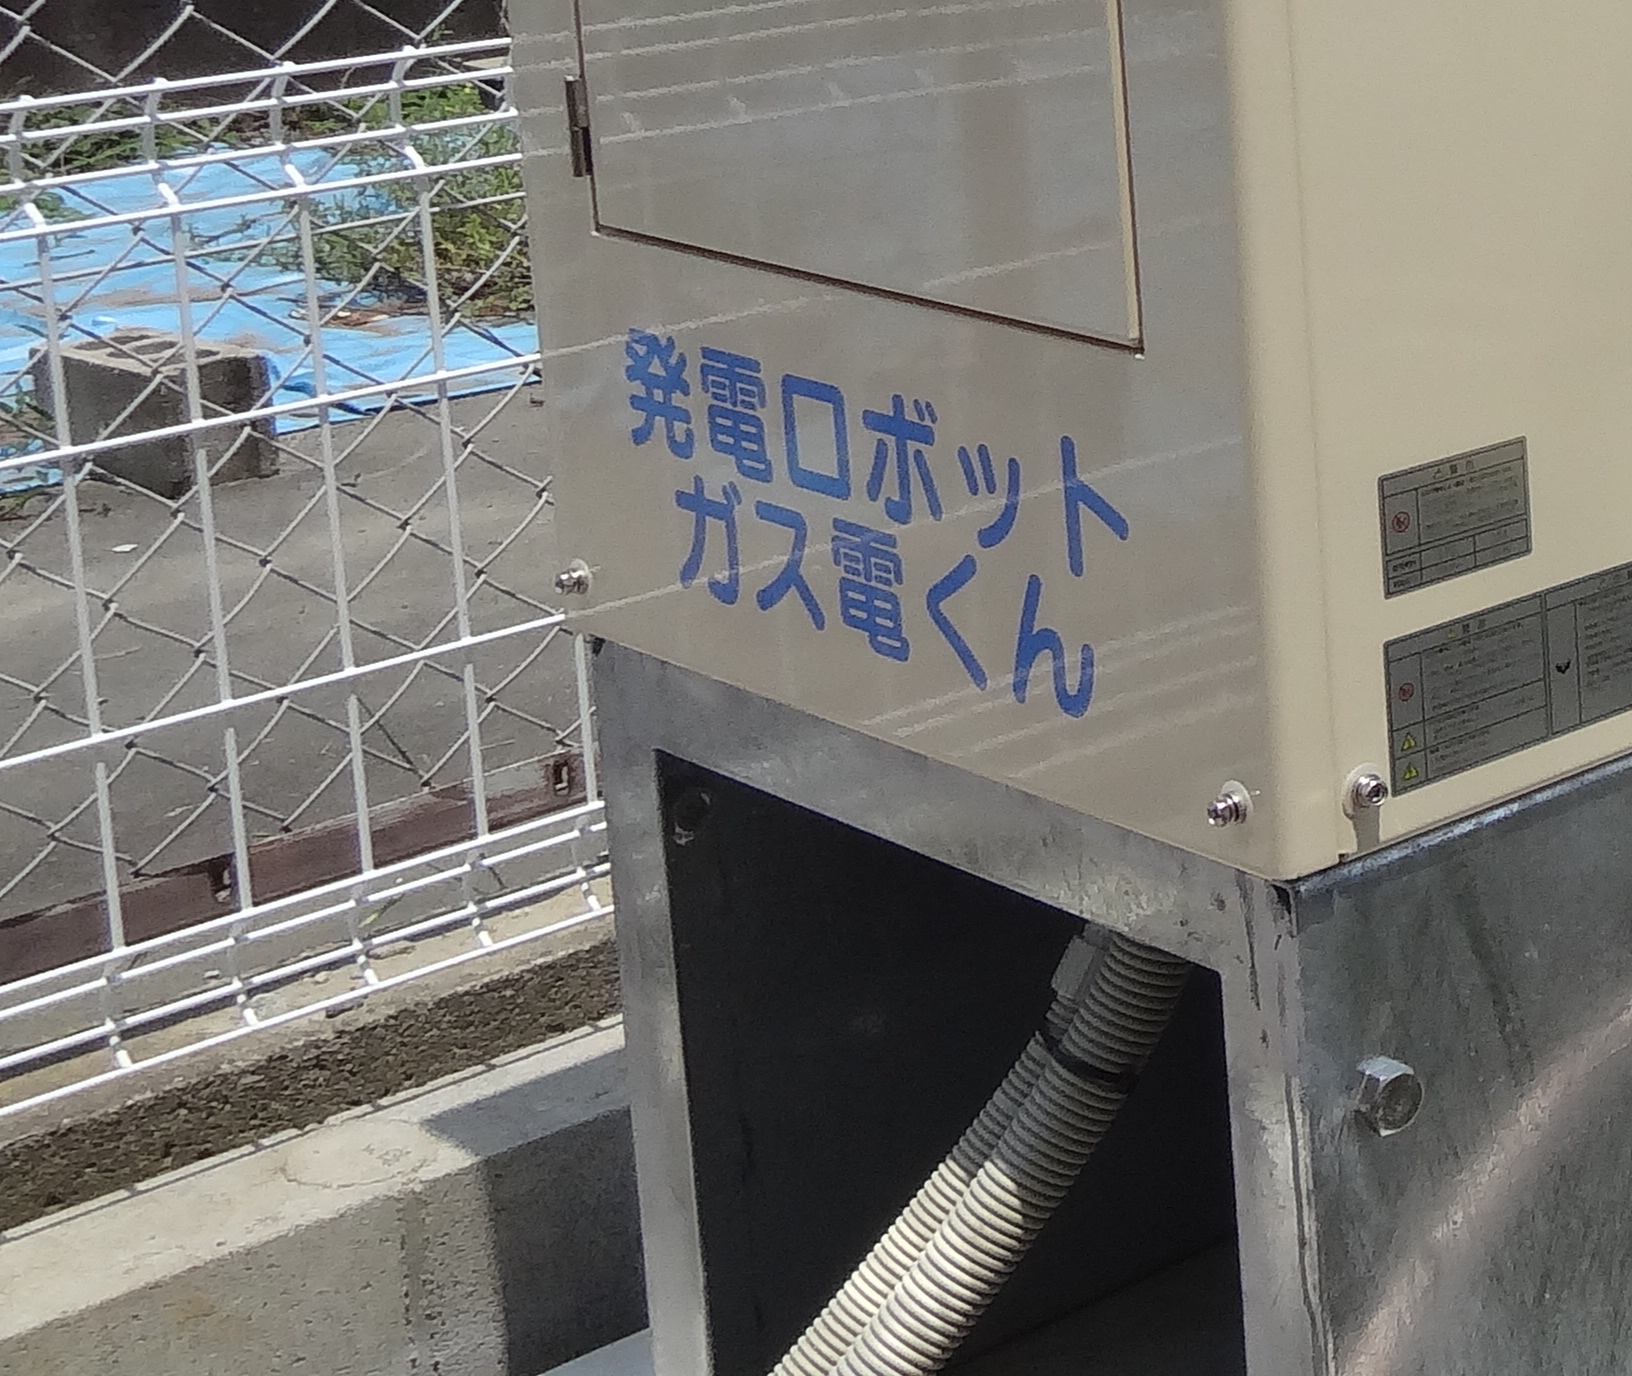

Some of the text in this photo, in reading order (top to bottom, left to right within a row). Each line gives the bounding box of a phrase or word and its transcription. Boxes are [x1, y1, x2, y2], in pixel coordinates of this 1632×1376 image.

[625, 327, 1130, 577] 発電ロボット
[675, 474, 1096, 718] ガス電くん
